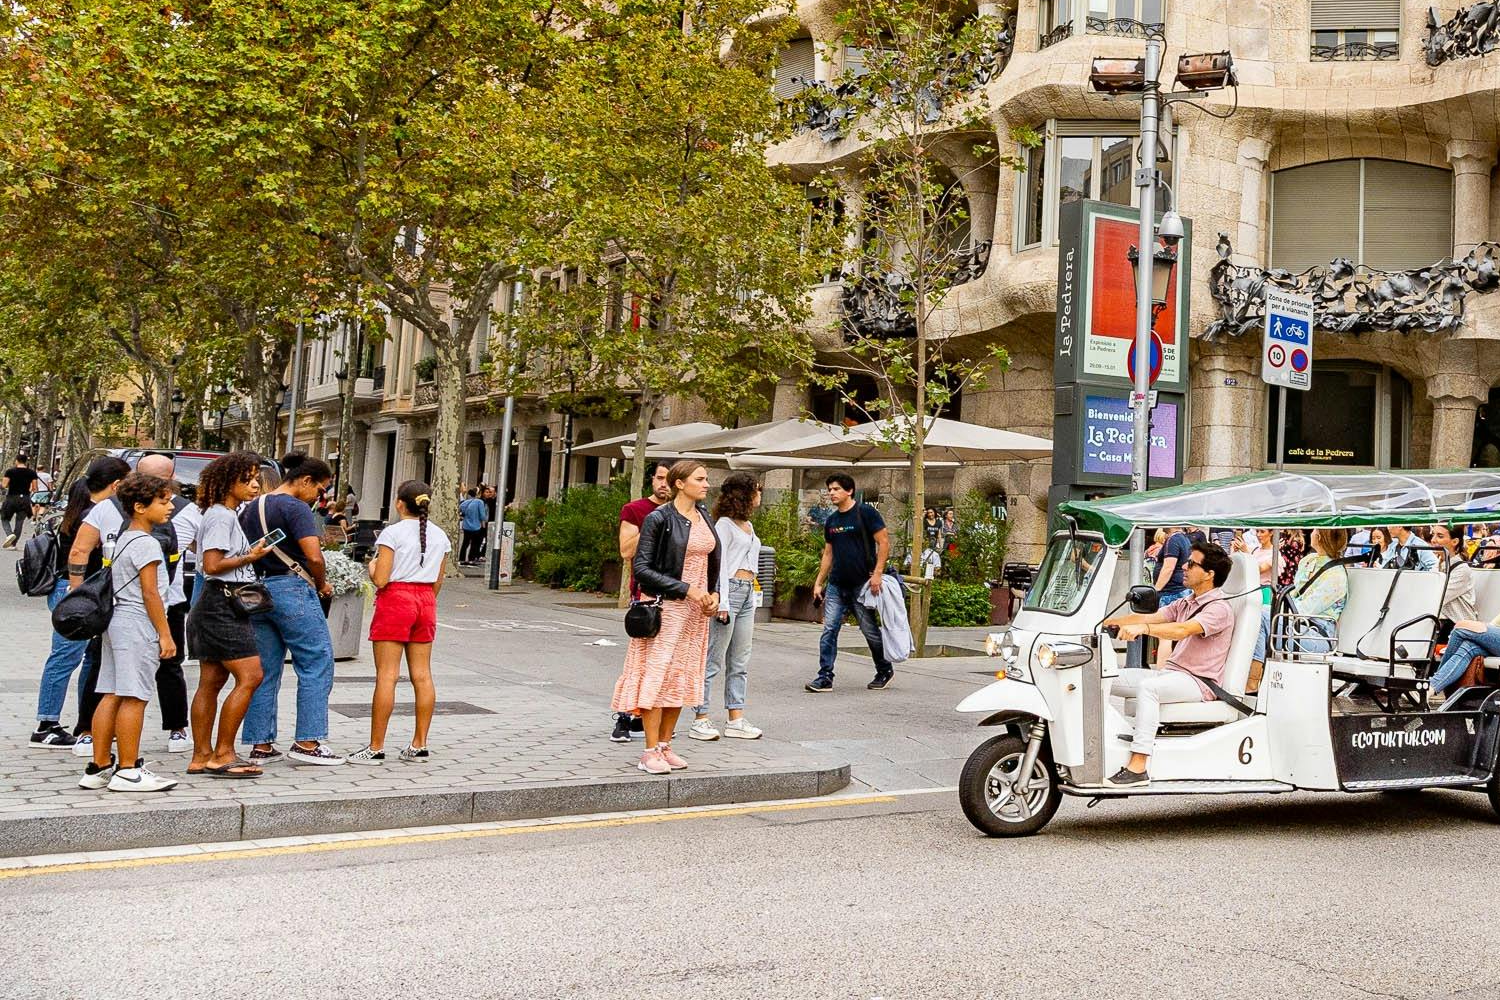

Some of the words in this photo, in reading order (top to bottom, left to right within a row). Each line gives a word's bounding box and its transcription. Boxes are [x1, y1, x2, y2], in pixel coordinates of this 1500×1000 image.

[1061, 247, 1075, 333] Pedrera
[1268, 293, 1282, 303] Zona
[1283, 297, 1290, 305] de
[1291, 299, 1313, 310] prioritat
[1271, 303, 1280, 311] per
[1286, 306, 1309, 316] vianants
[1060, 334, 1073, 357] La
[1272, 351, 1281, 360] 10
[1087, 425, 1104, 447] La
[1105, 427, 1168, 448] Pedra
[1099, 450, 1122, 462] Casa
[1305, 448, 1315, 456] de
[1316, 448, 1324, 456] la
[1325, 449, 1354, 457] Pedrera
[1352, 729, 1446, 749] ECOTUKTUK.COM
[1238, 735, 1254, 765] 6
